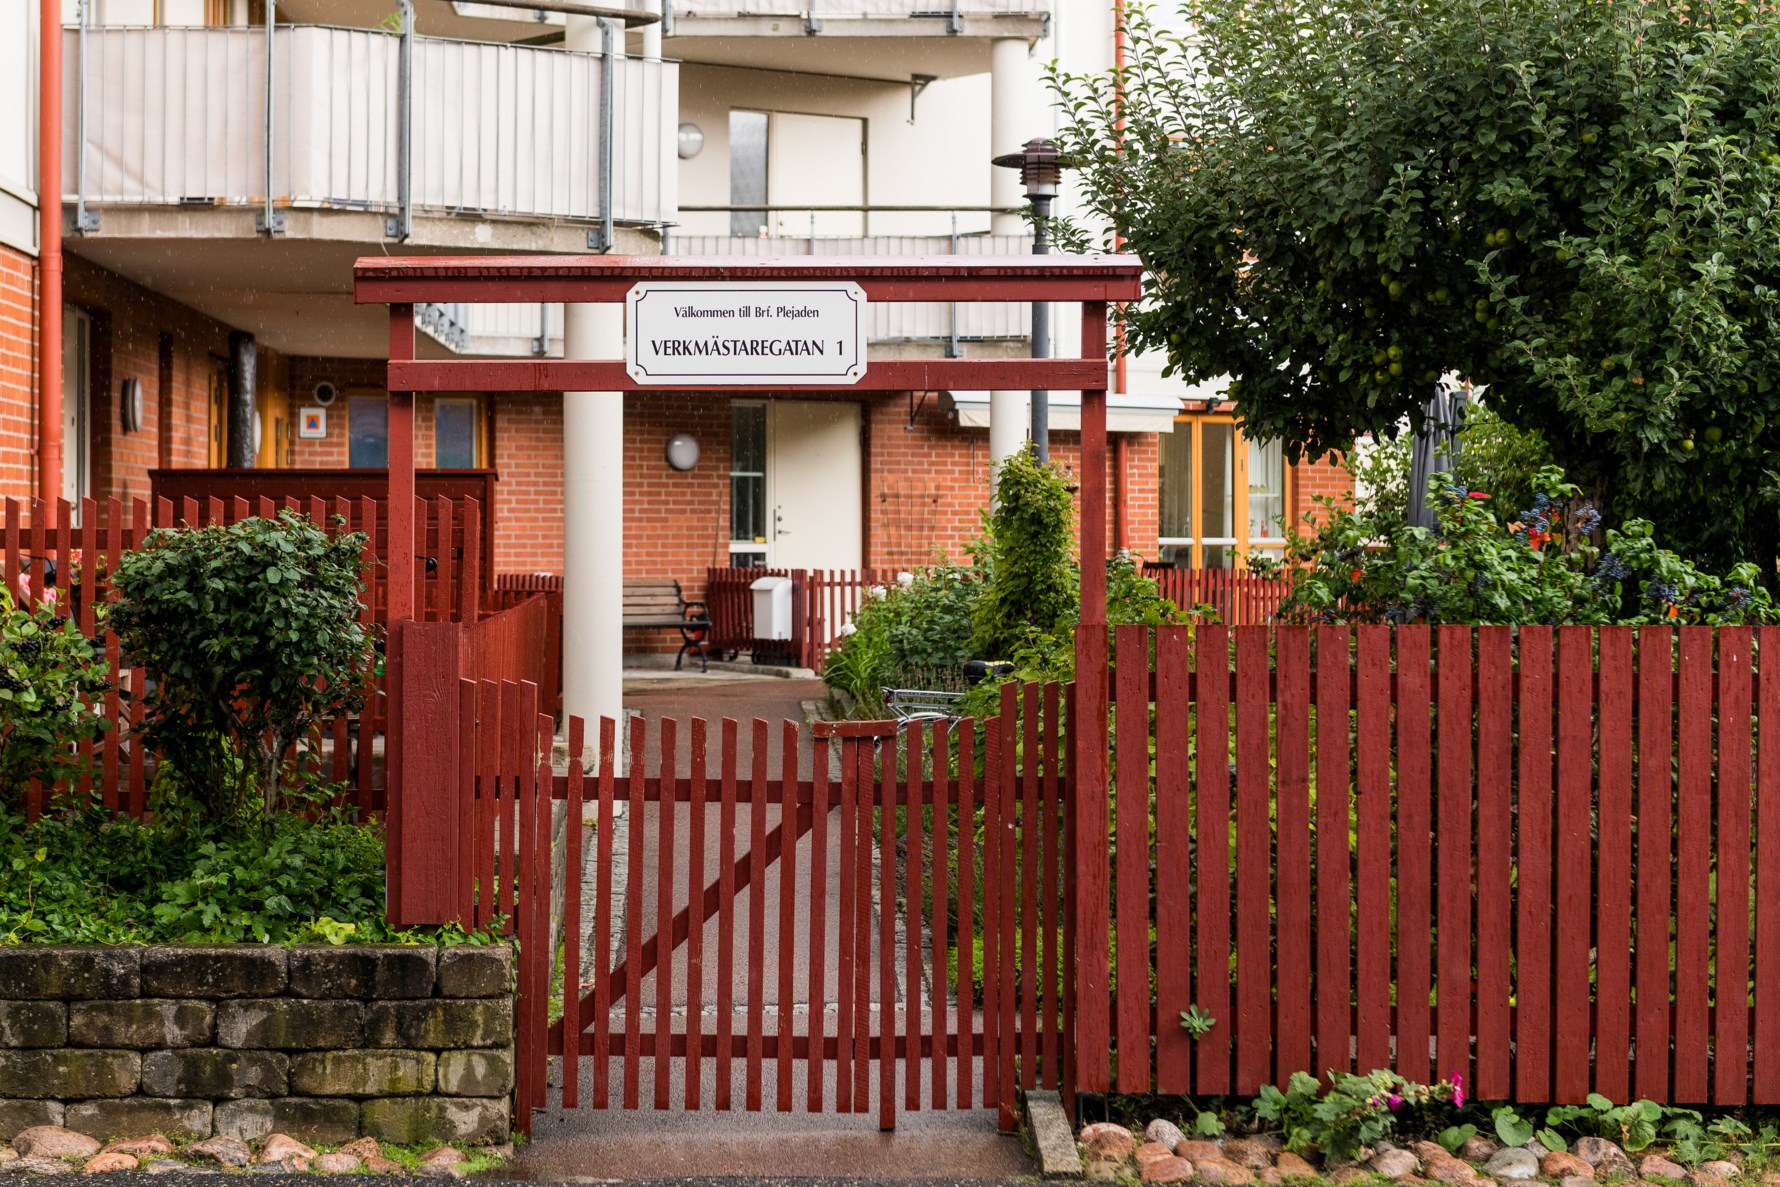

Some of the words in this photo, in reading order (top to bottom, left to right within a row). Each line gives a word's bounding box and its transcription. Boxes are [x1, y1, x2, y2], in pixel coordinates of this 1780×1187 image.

[674, 305, 735, 318] Välkommen
[738, 305, 751, 318] till
[755, 305, 773, 318] Brf.
[776, 305, 819, 321] Plejaden
[651, 335, 825, 356] VERKMÄSTAREGATAN
[836, 339, 843, 356] 1
